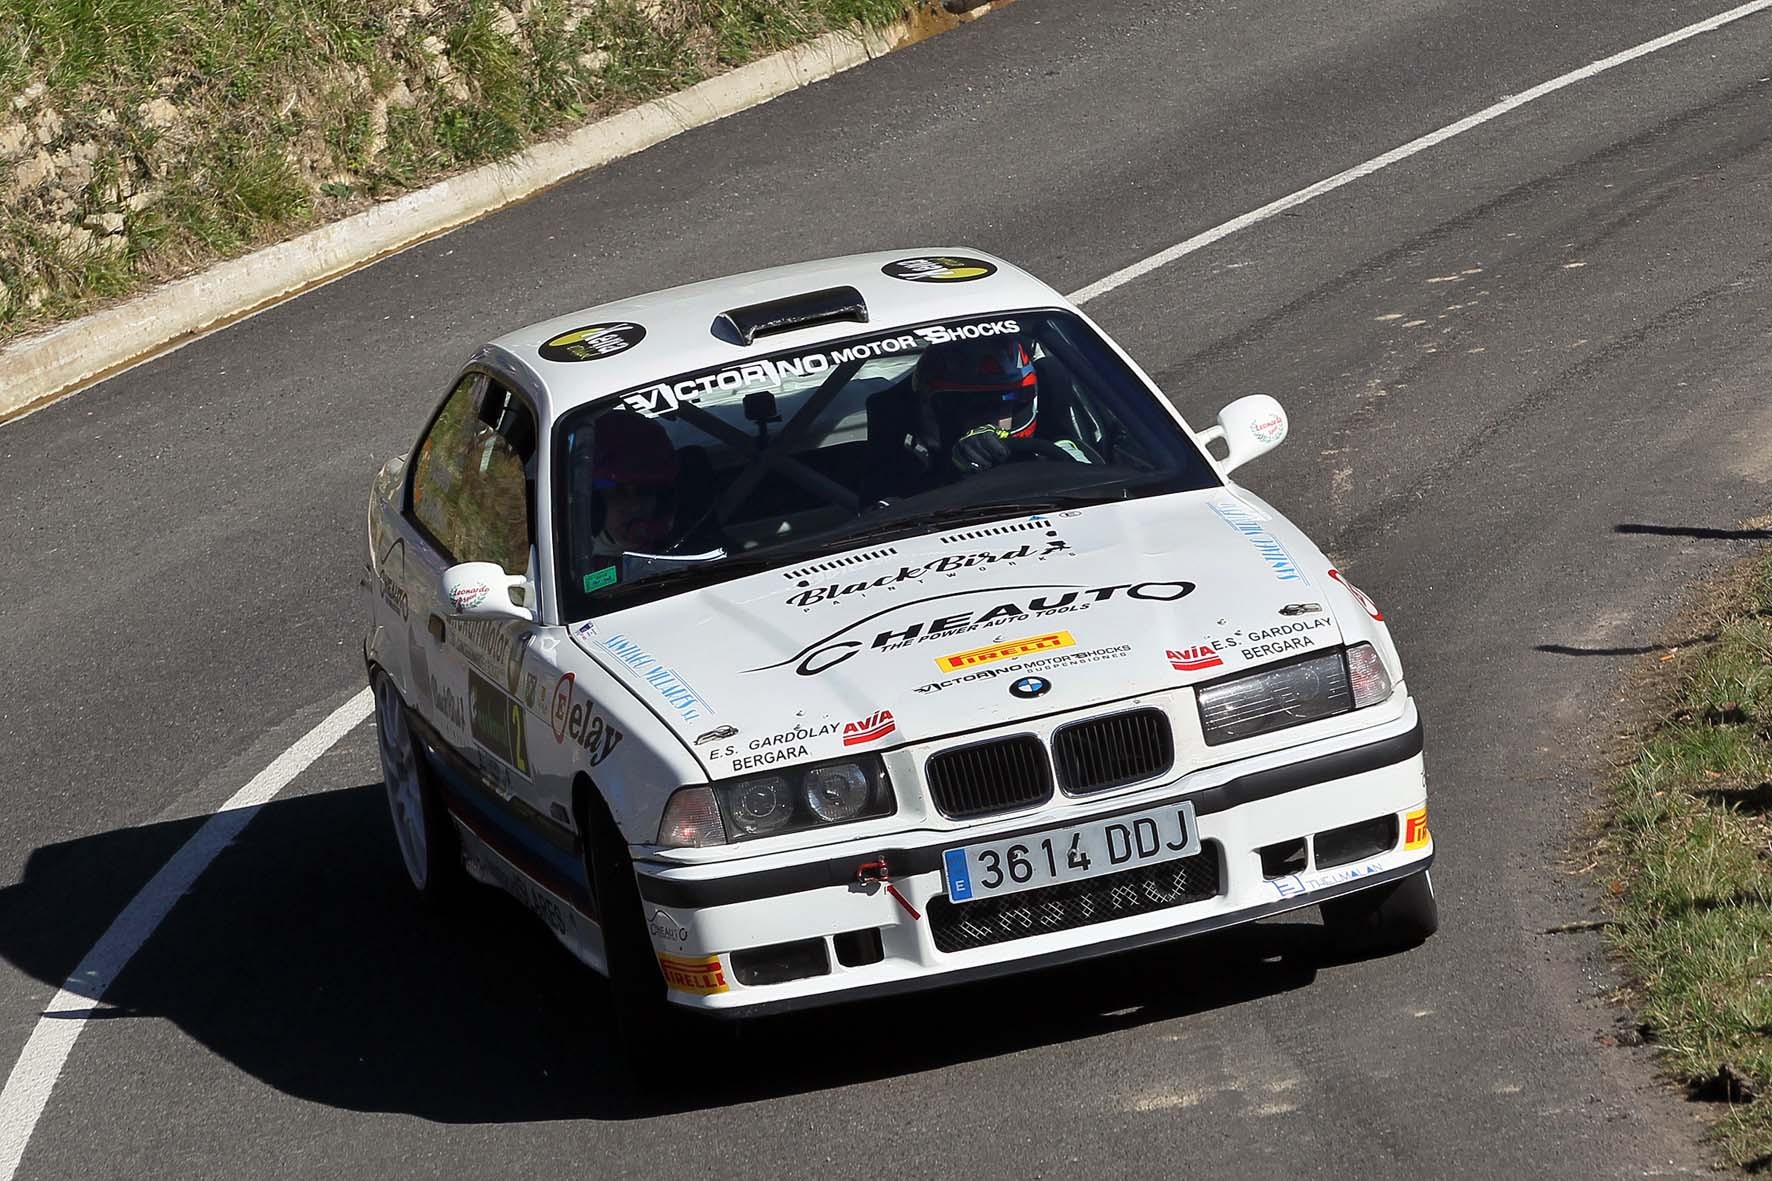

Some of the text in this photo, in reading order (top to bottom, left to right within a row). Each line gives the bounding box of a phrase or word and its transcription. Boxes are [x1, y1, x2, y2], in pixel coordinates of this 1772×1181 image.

[622, 320, 1021, 418] VICTORINO MOTOR SHOCKS
[803, 550, 1076, 613] PAINTWORKS
[796, 581, 1196, 677] CHEAUTO
[881, 602, 1090, 652] THE POWER AUTO TOOLS
[949, 634, 1062, 667] PIRELLI
[1211, 616, 1333, 651] E.S. GARDOLAY
[1241, 635, 1315, 660] BERGARA
[912, 645, 1131, 694] VICTORINO MOTOR SHOCKS
[709, 722, 841, 760] E.S. GARDOLAY
[732, 745, 809, 771] BERGARA
[955, 810, 1188, 892] E 3614 DDJ
